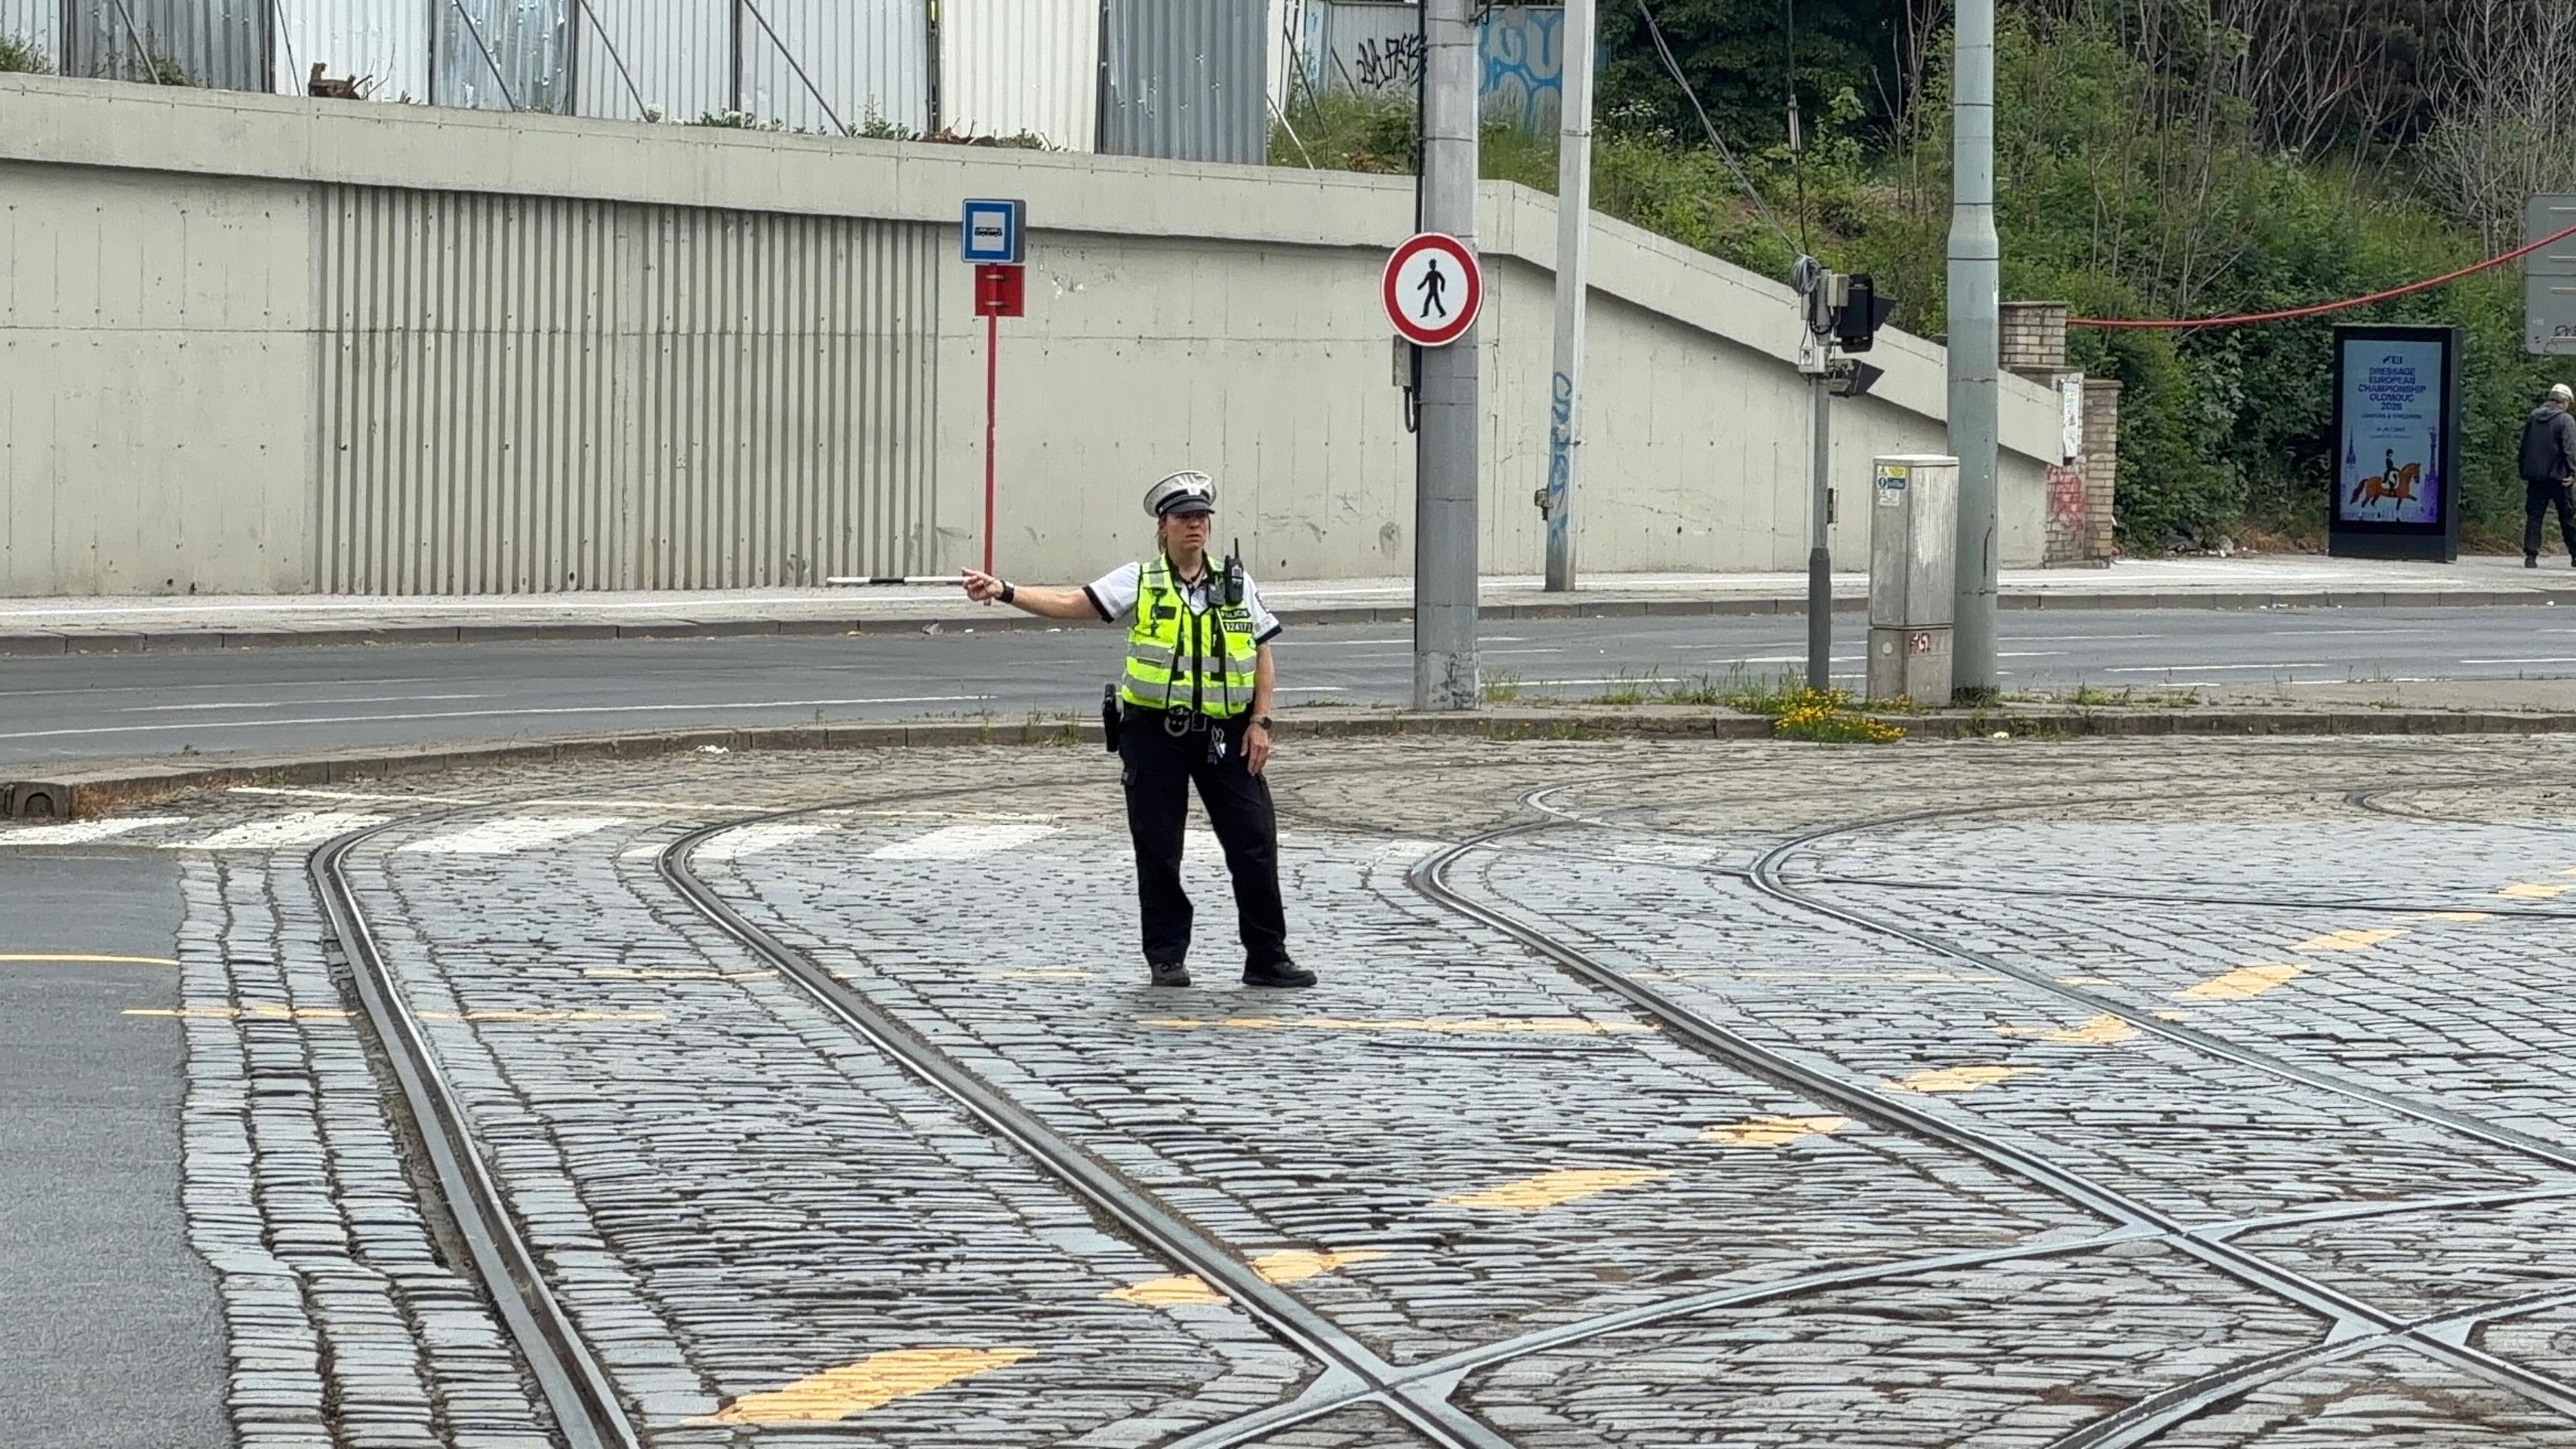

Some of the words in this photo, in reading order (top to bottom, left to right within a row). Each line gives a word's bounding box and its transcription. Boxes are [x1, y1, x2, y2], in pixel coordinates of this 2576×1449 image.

[2369, 367, 2416, 375] DRESSAGE
[2369, 376, 2416, 384] EUROPEAN
[2358, 384, 2427, 393] CHAMPIONSHIP
[2369, 393, 2414, 402] OLOMOUC
